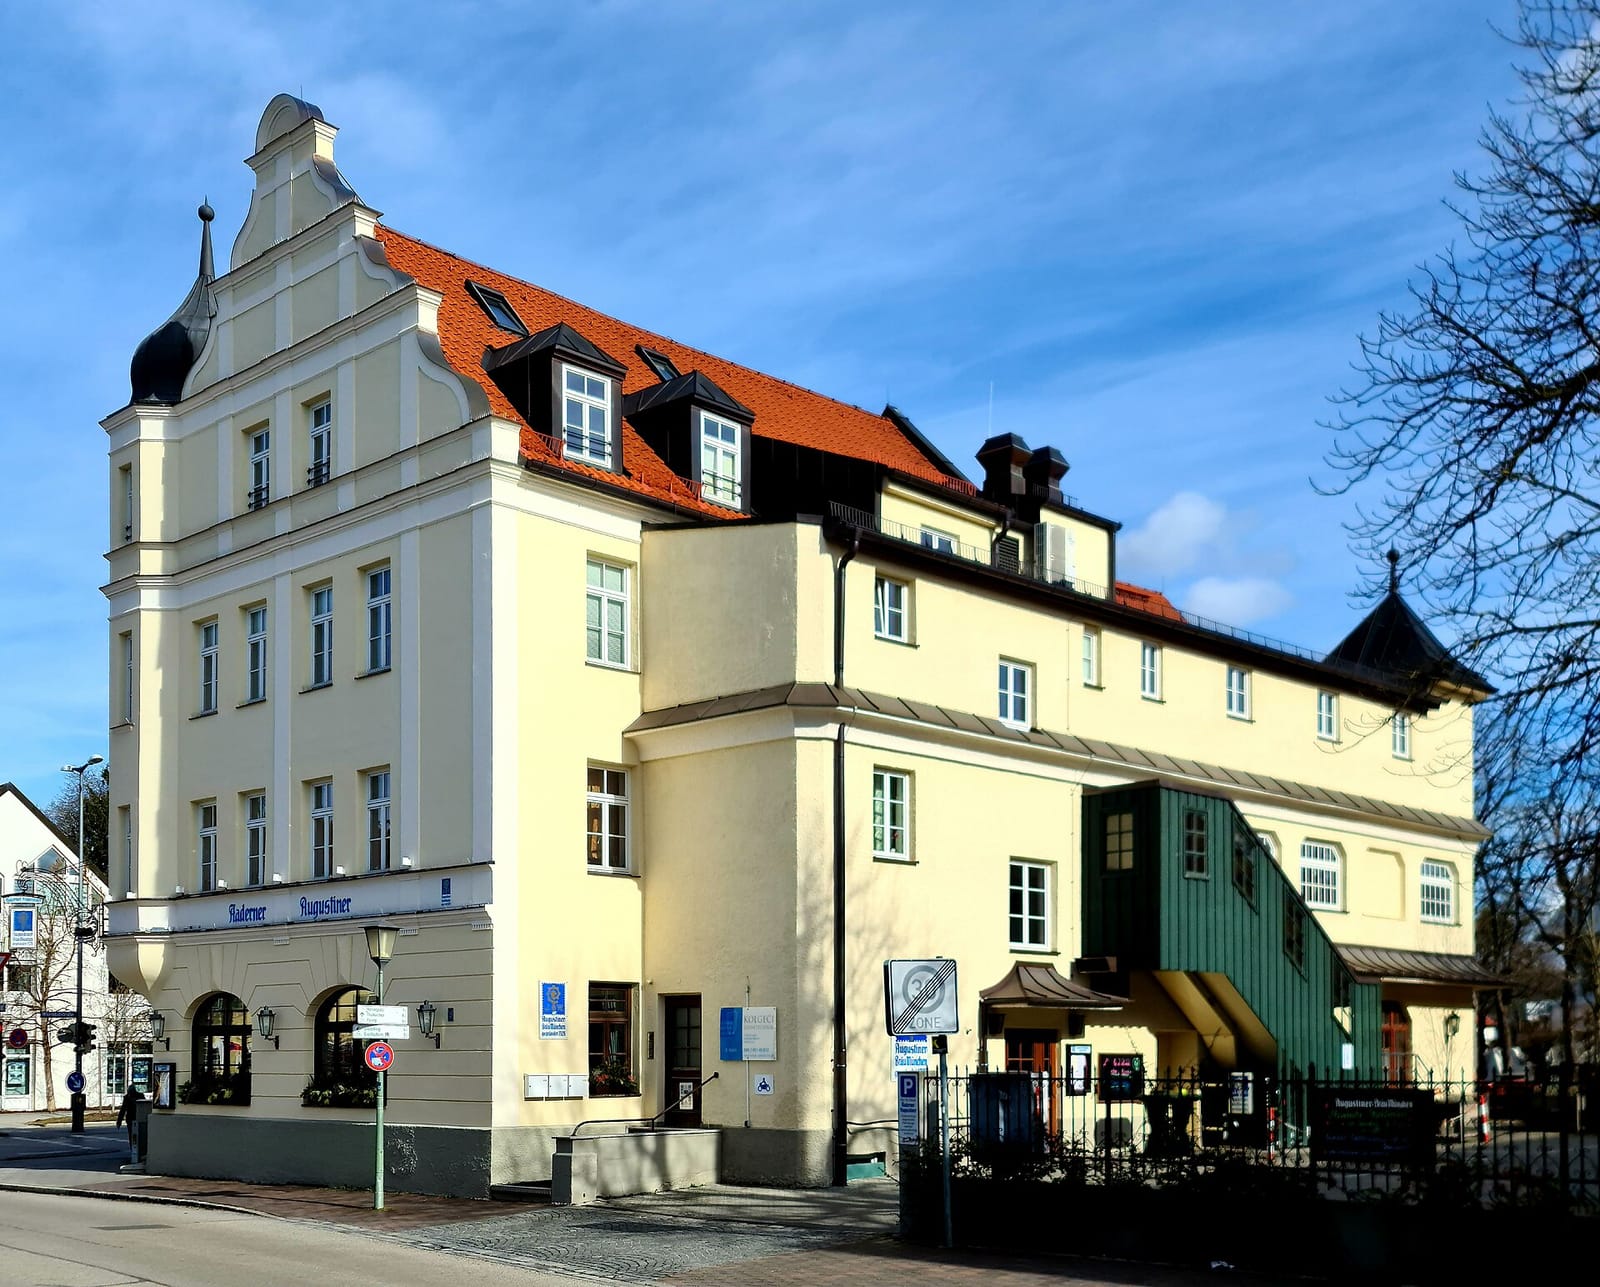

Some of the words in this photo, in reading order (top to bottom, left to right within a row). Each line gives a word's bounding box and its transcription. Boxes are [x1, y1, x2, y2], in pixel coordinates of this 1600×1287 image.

[299, 896, 352, 919] Augustiner
[909, 1016, 942, 1029] ZONE
[895, 1043, 928, 1056] Augustiner
[903, 1078, 914, 1095] P
